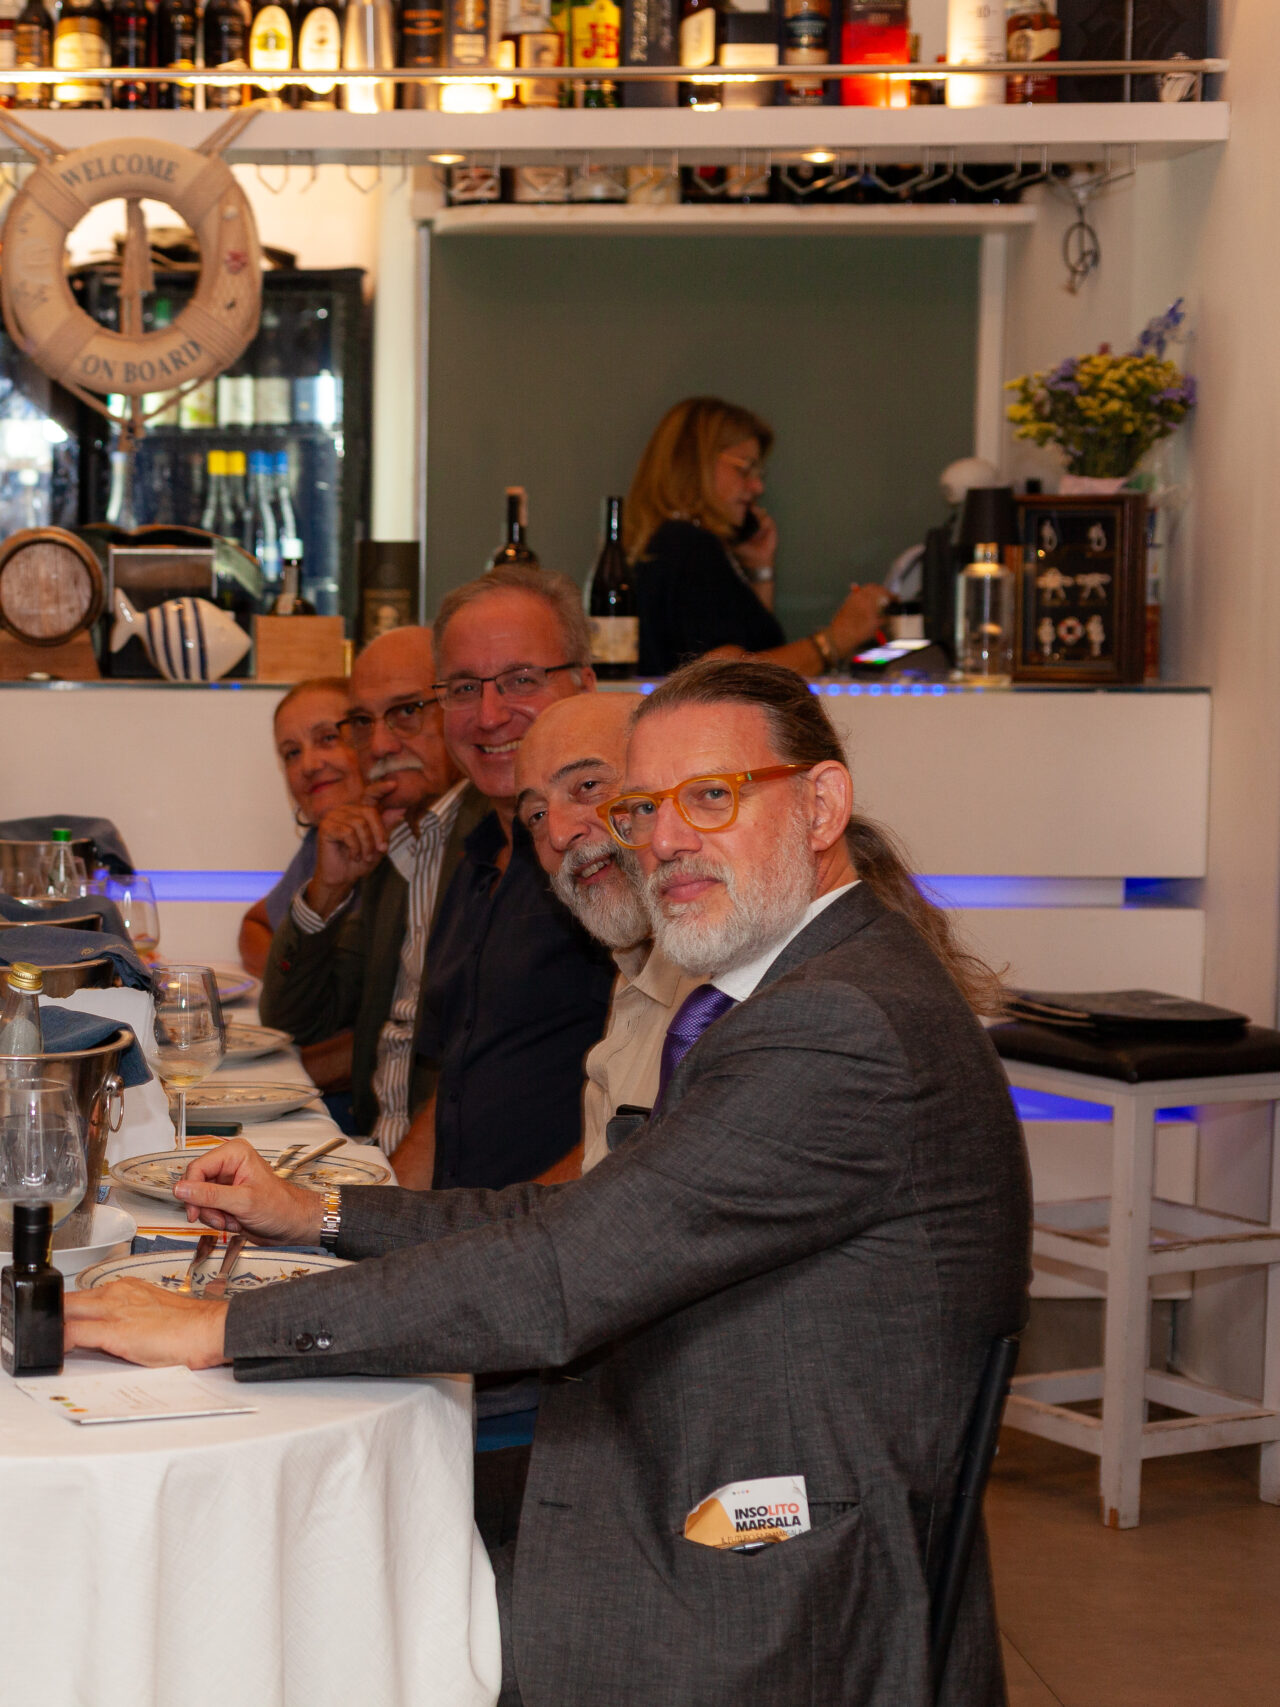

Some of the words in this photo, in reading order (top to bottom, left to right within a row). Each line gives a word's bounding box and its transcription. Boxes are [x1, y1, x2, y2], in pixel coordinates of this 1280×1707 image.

[60, 152, 180, 187] WELCOME
[81, 353, 115, 379] ON
[122, 339, 203, 384] BOARD
[734, 1503, 800, 1520] INSOLITO
[735, 1515, 802, 1533] MARSALA
